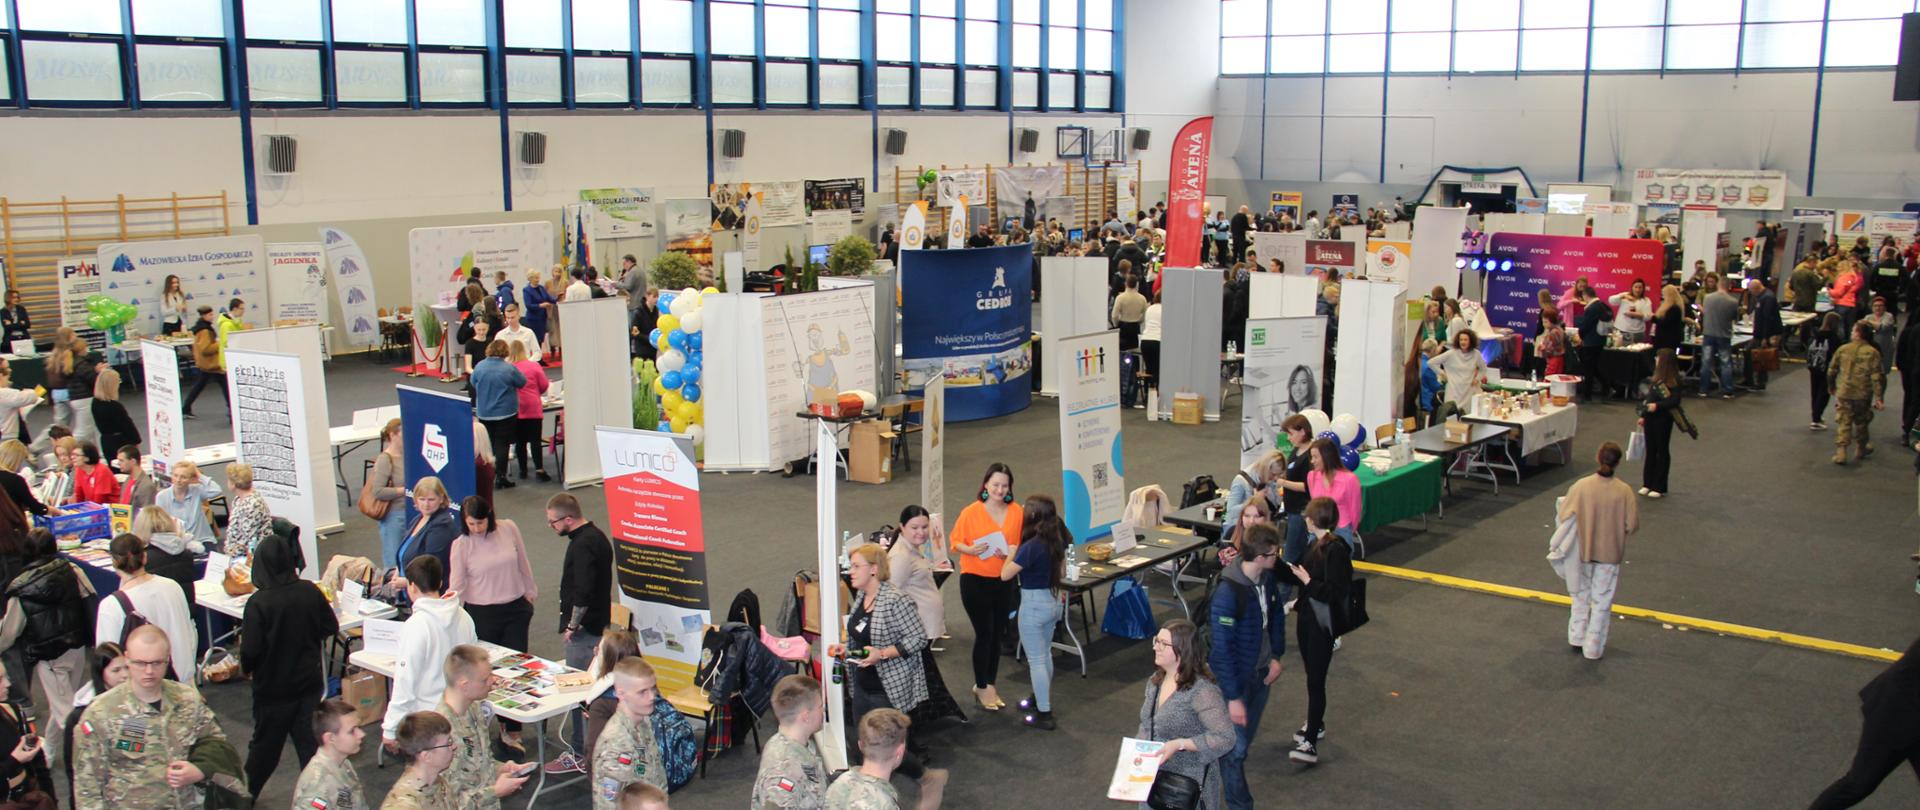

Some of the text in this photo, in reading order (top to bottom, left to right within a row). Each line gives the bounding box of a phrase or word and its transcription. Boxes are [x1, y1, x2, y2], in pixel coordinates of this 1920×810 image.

[1187, 132, 1203, 189] ATENA
[139, 257, 188, 266] MAZOWIECKA
[204, 250, 254, 261] GOSPODARCZA
[273, 257, 318, 266] JAGIENKA
[935, 333, 977, 345] Największy
[235, 366, 285, 380] ekslibris
[426, 449, 445, 461] OHP
[614, 448, 675, 473] LUMICO
